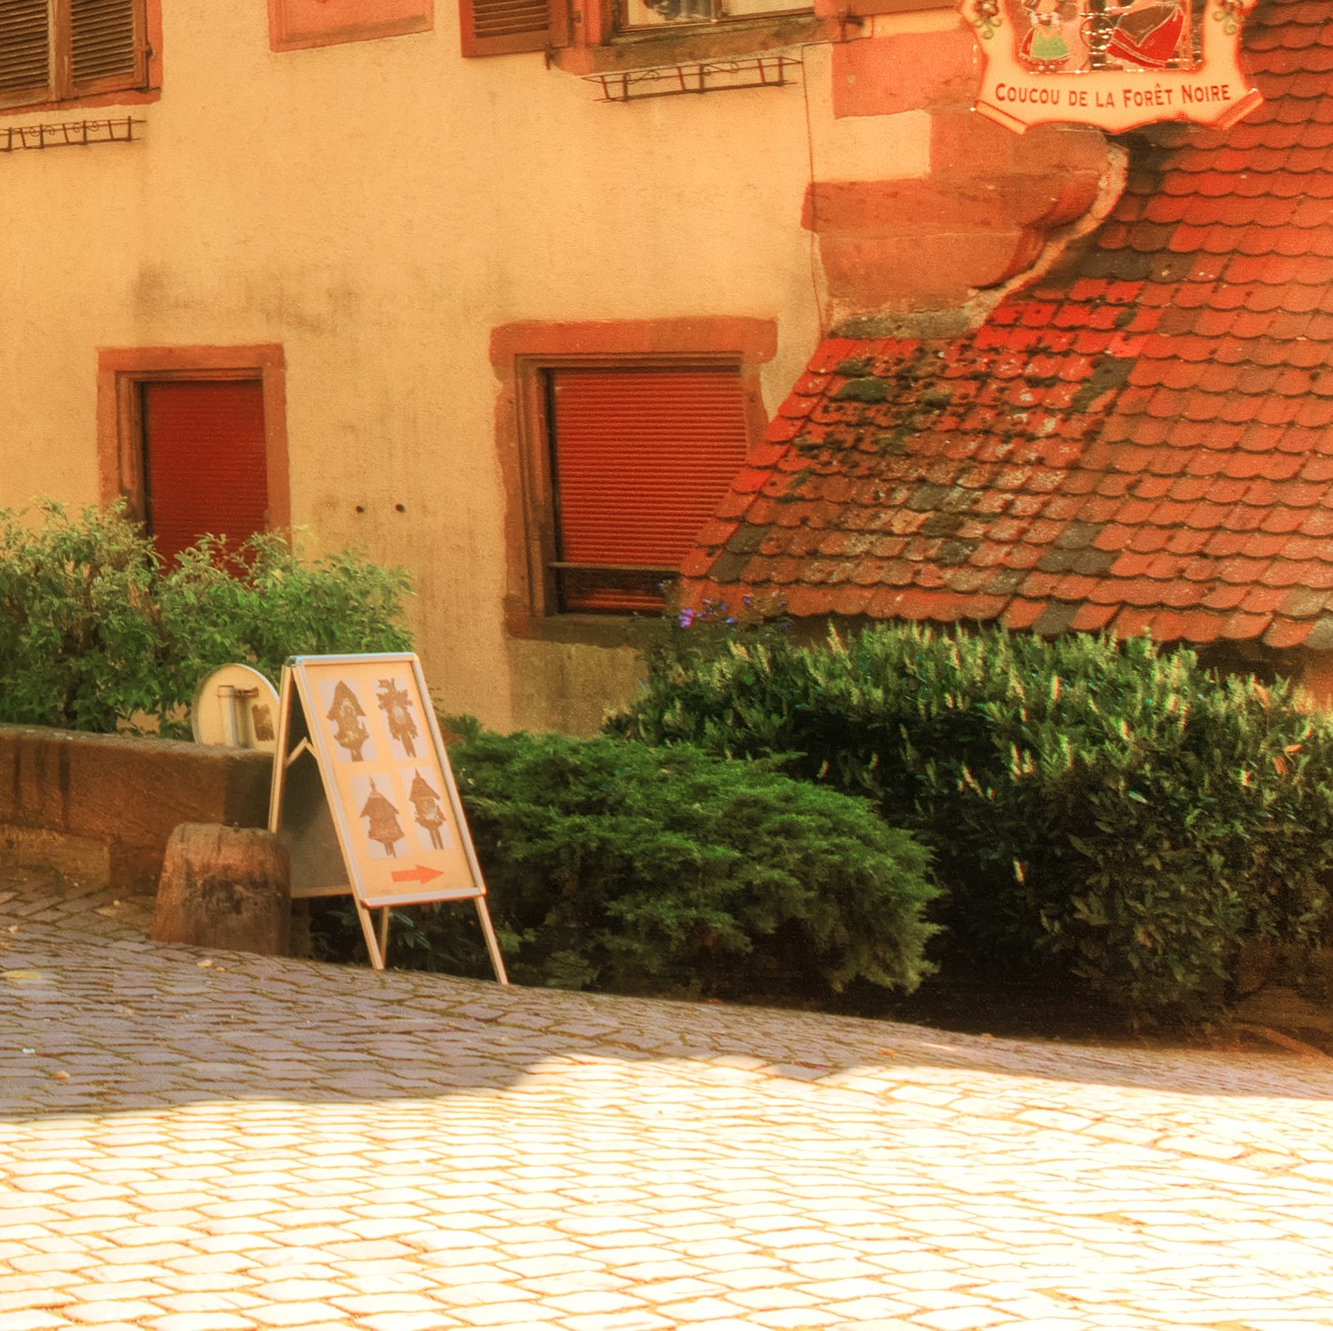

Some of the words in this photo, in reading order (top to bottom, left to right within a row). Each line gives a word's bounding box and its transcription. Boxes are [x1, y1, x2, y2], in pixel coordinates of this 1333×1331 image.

[994, 82, 1060, 106] COUCOU
[1068, 90, 1089, 108] DE
[1095, 91, 1115, 109] LA
[1123, 82, 1173, 108] FORÊT
[1182, 83, 1231, 104] NOIRE
